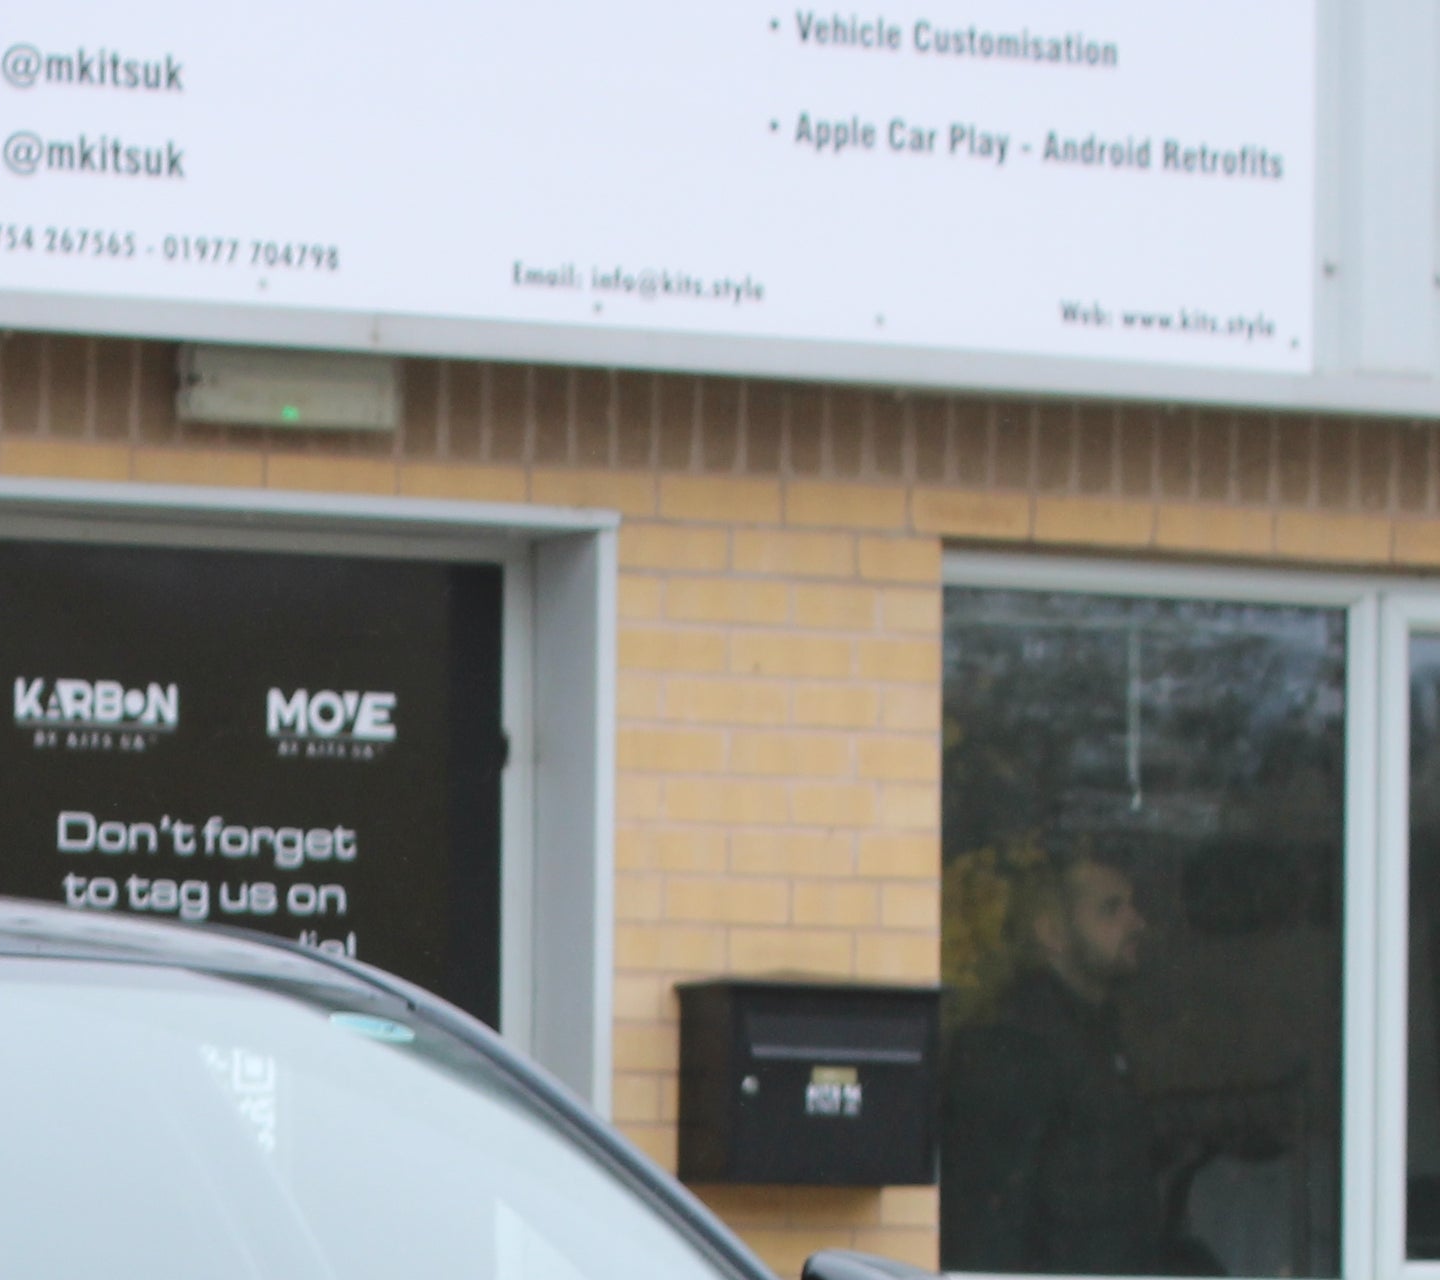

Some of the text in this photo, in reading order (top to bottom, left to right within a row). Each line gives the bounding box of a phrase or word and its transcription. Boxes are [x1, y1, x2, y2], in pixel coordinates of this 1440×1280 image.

[795, 11, 1118, 68] Vehicle Customisation
[2, 42, 185, 91] @mkitsuk
[4, 129, 186, 178] @mkitsuk
[795, 112, 876, 154] Apple
[889, 118, 937, 154] Car
[949, 123, 1009, 166] Play
[1043, 130, 1151, 170] Android
[1163, 138, 1284, 180] Retrofits
[45, 226, 136, 258] 267565
[163, 234, 239, 264] 01977
[250, 239, 340, 271] 704798
[57, 811, 357, 869] Don't forget
[64, 872, 347, 922] to tag us on
